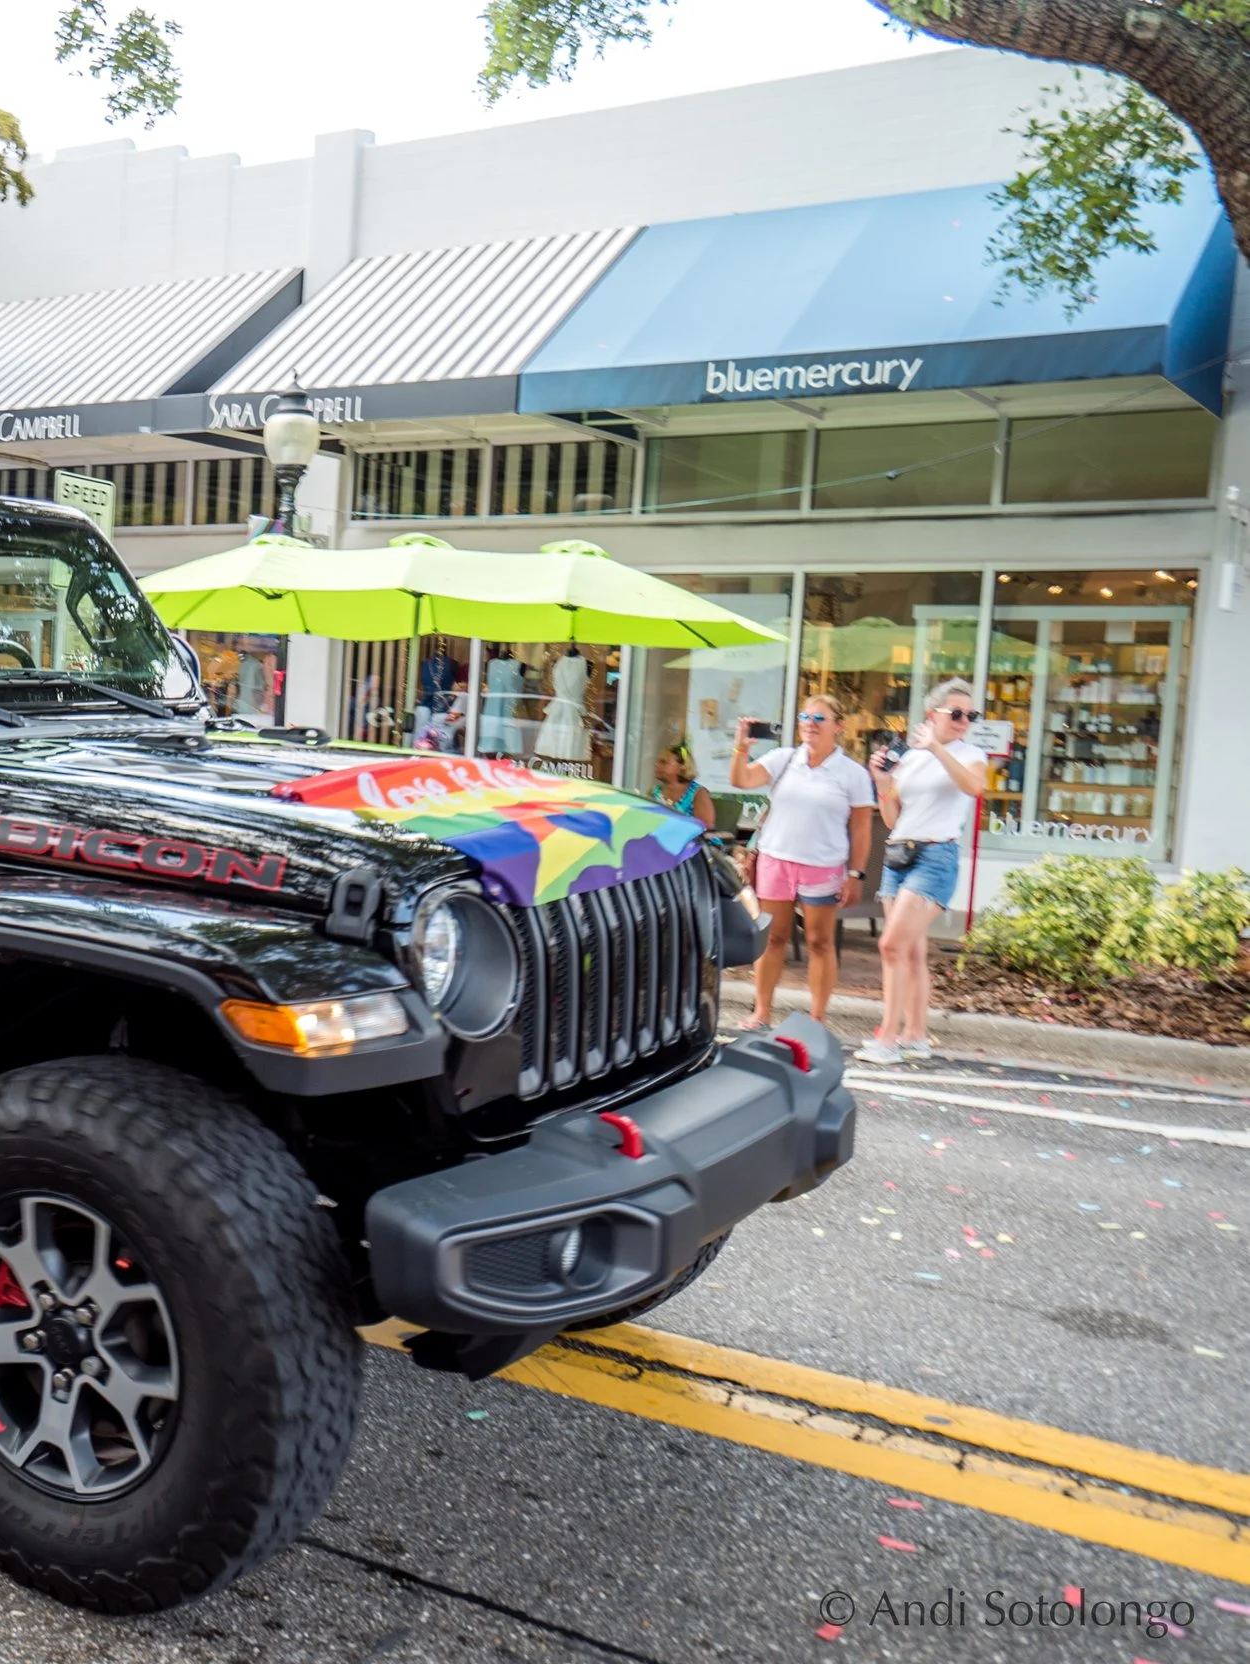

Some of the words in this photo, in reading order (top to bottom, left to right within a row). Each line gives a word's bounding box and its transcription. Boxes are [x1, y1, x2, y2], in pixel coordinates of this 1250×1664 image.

[706, 358, 924, 394] bluemercury
[258, 394, 364, 424] CPBELL
[62, 482, 107, 506] SPEED
[989, 810, 1158, 849] bluemercury
